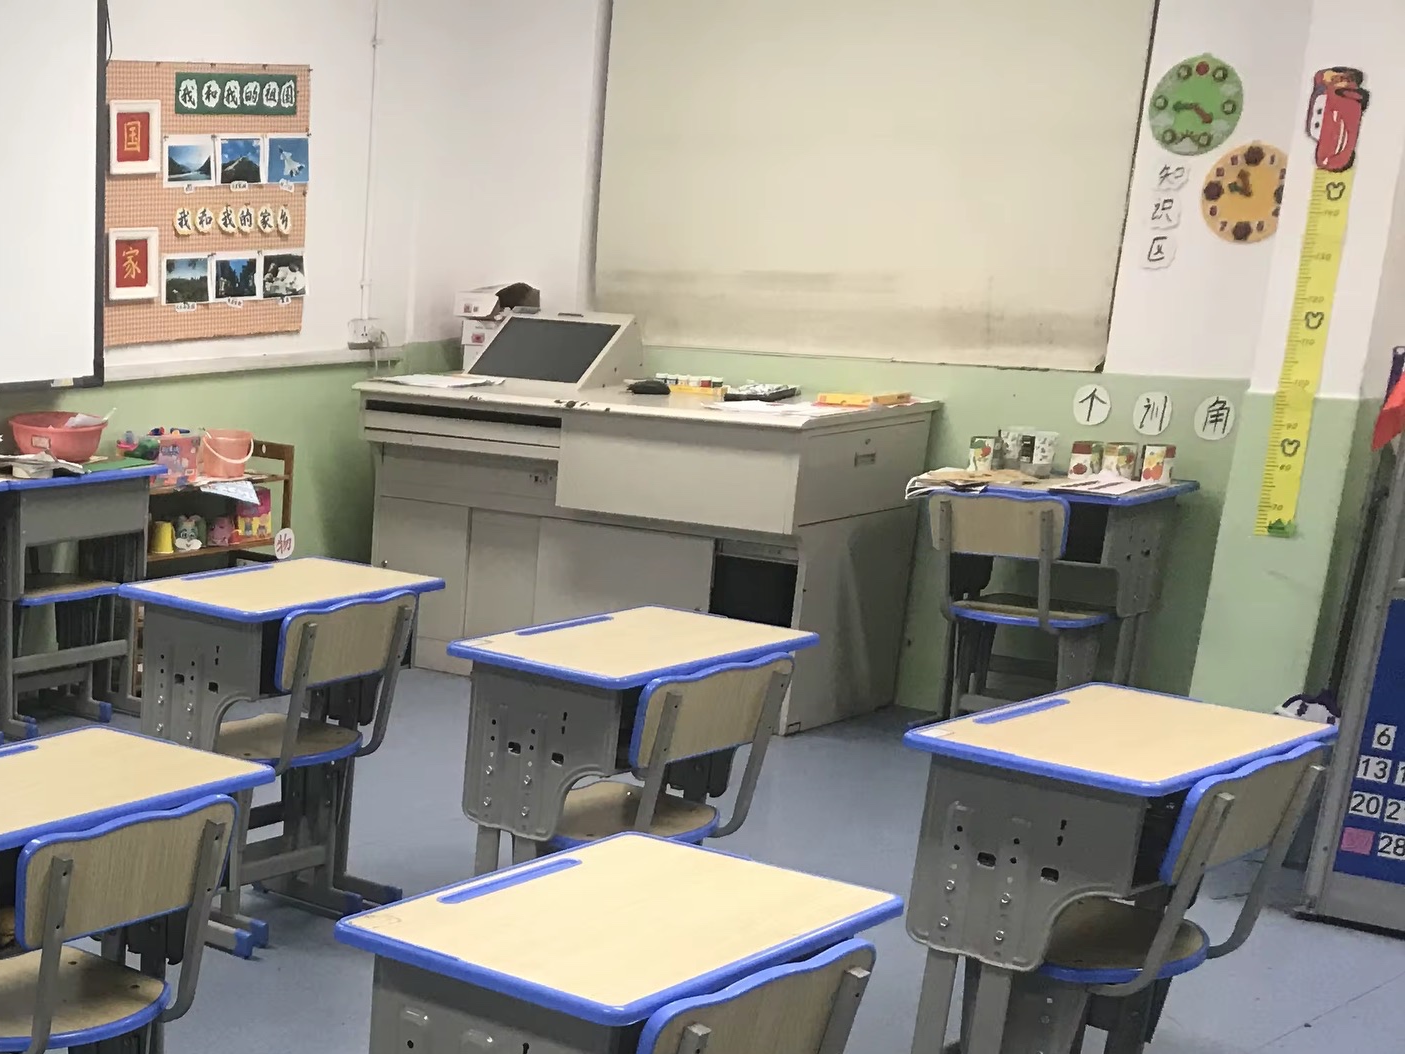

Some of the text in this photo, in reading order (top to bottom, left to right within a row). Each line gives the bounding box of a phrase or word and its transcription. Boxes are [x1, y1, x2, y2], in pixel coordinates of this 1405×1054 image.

[181, 83, 293, 107] 我和我的祖国
[124, 120, 141, 152] 国
[177, 207, 289, 231] 我和我的家乡
[1147, 163, 1186, 262] 知识区
[122, 246, 141, 280] 家
[1376, 727, 1392, 747] 6
[1360, 757, 1388, 780] 13
[1350, 793, 1405, 821] 20 2
[1377, 834, 1405, 857] 28
